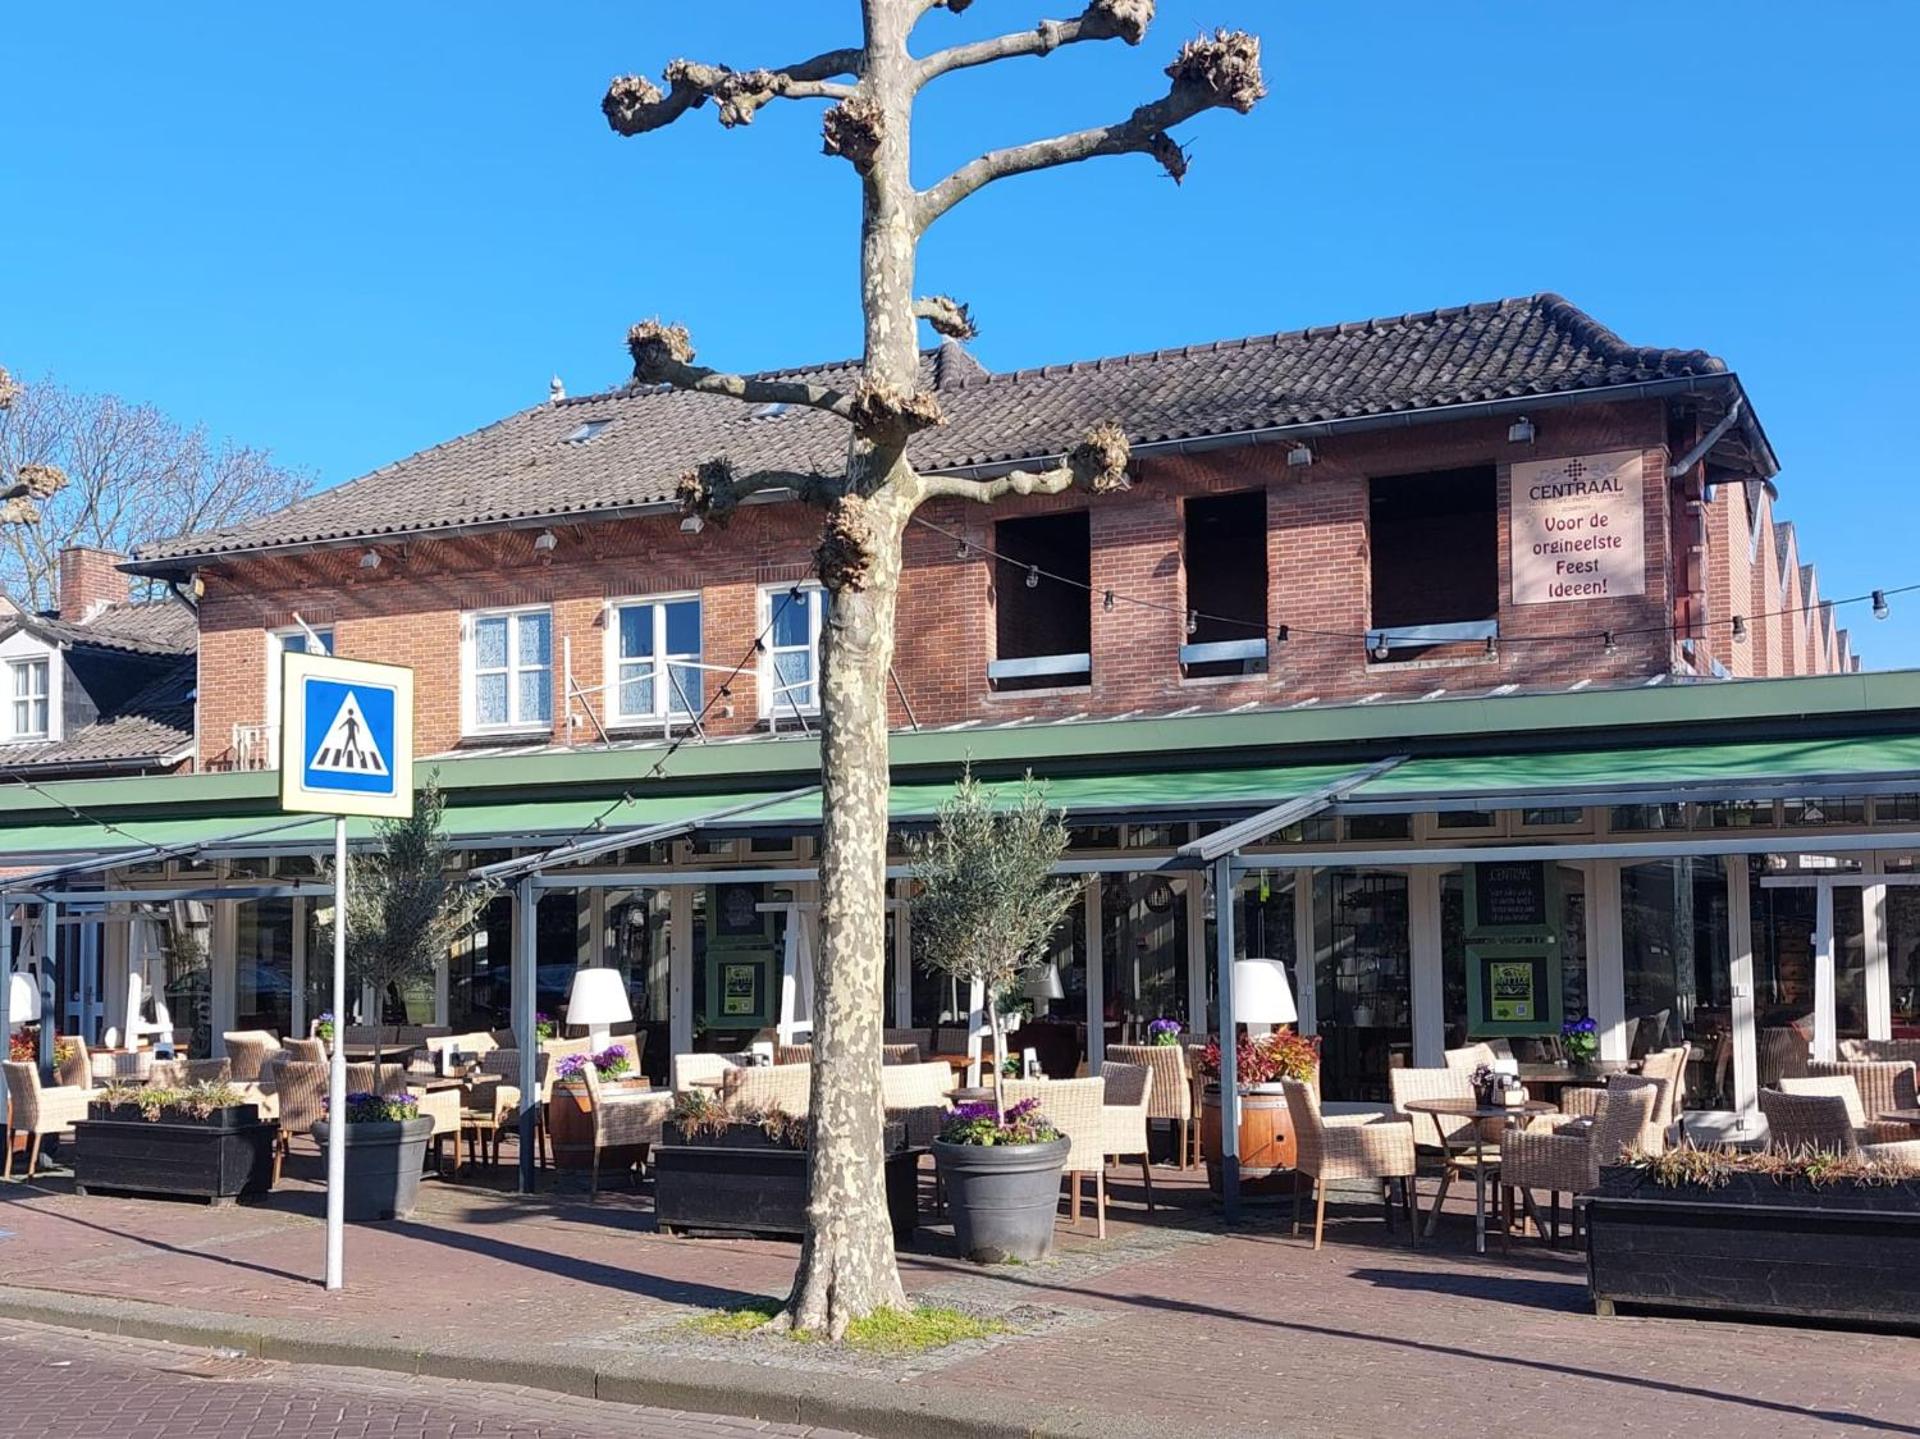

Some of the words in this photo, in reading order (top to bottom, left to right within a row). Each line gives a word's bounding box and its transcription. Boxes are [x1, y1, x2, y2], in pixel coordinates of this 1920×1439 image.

[1529, 478, 1624, 501] CENTRAAL
[1545, 516, 1584, 532] Voor
[1589, 513, 1609, 527] de
[1533, 535, 1622, 555] orgineelste
[1556, 559, 1599, 575] Feest
[1549, 578, 1608, 598] Ideeen!
